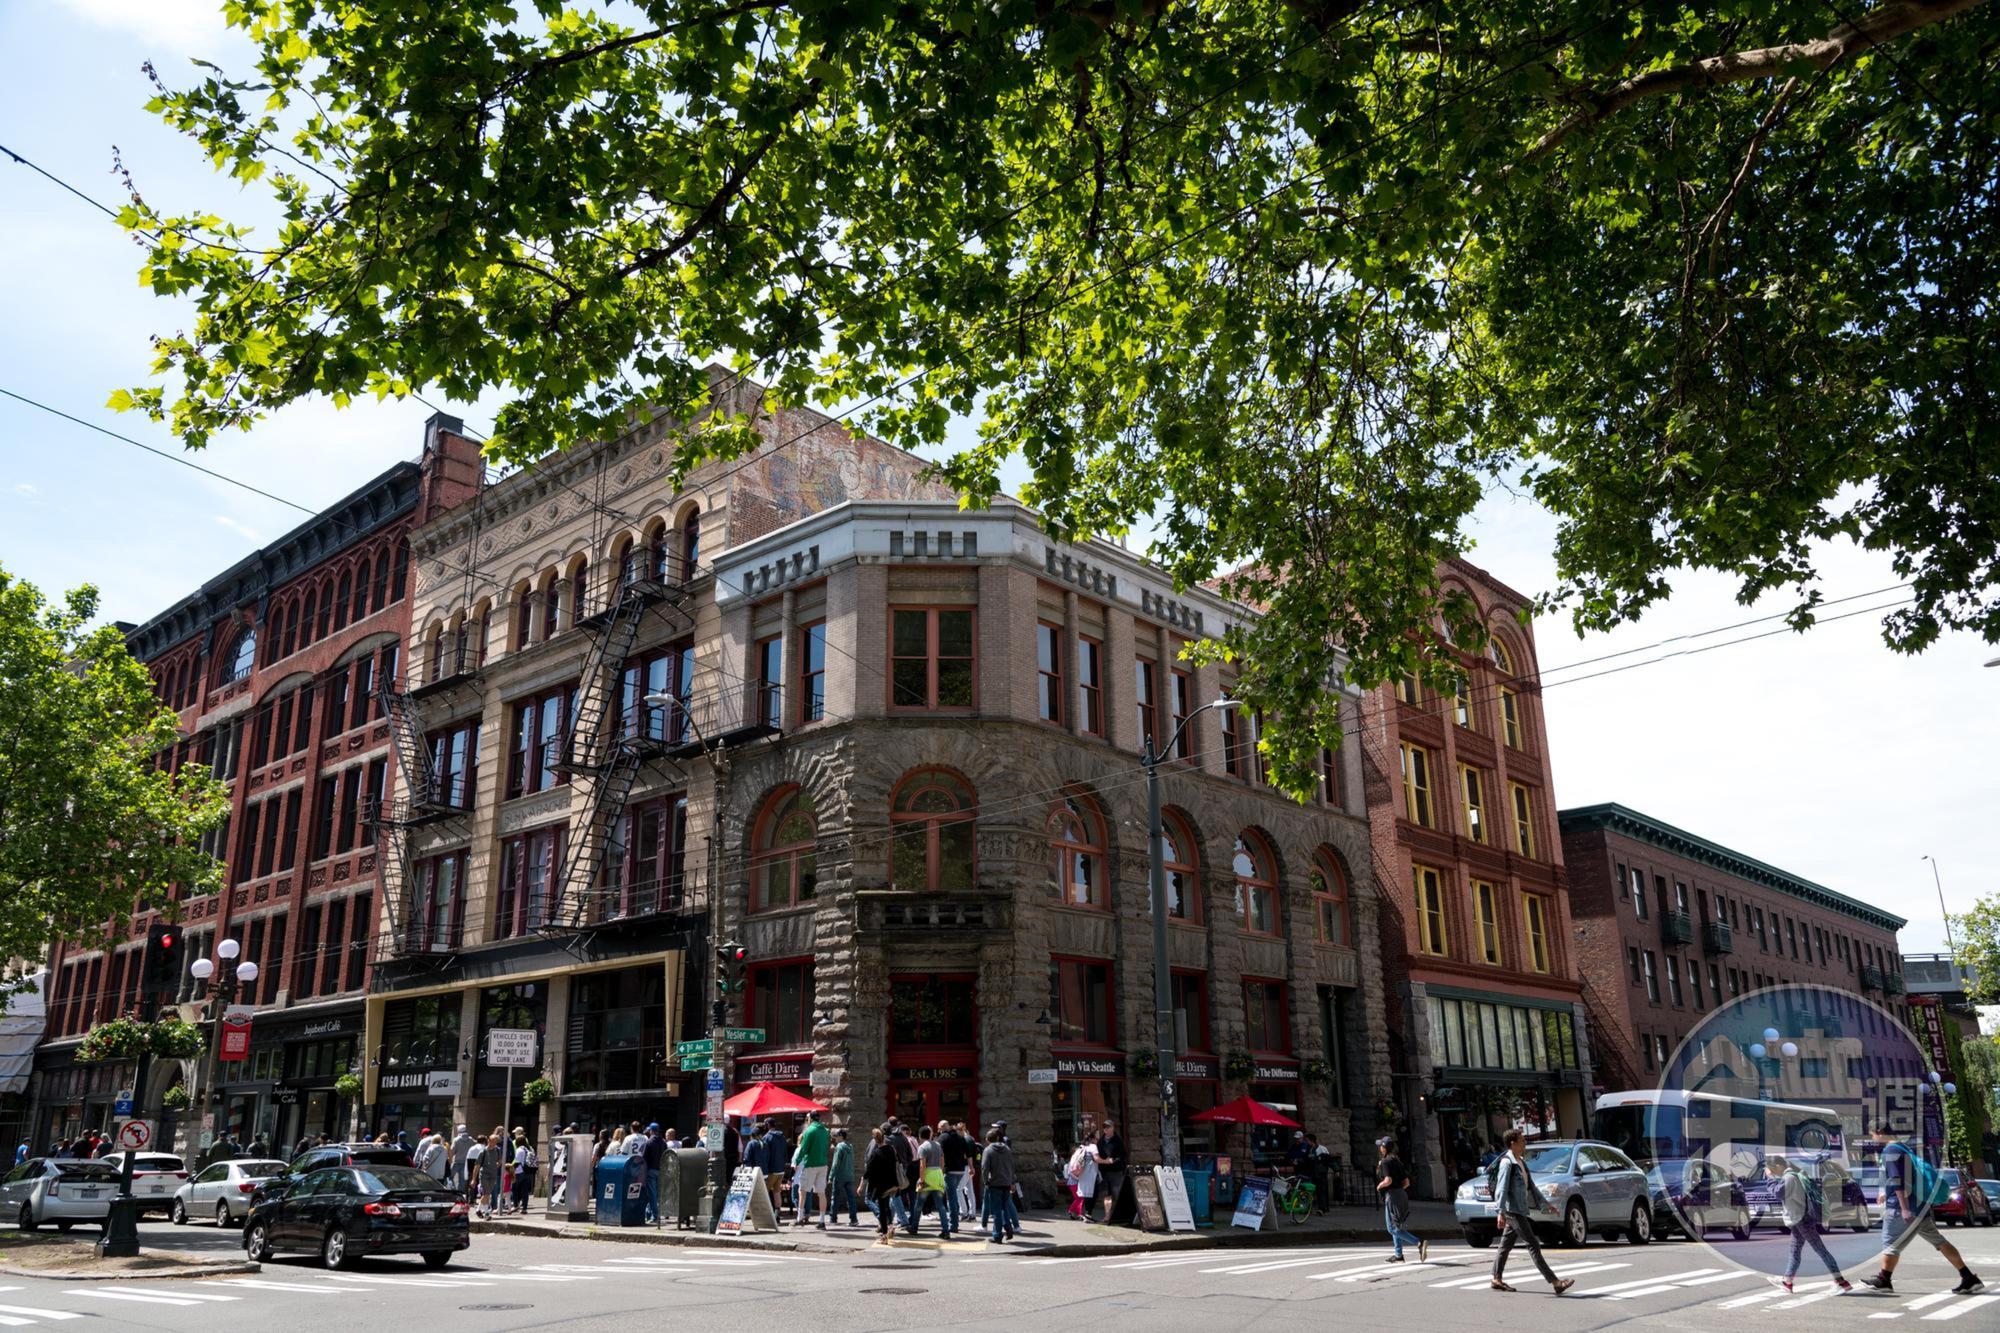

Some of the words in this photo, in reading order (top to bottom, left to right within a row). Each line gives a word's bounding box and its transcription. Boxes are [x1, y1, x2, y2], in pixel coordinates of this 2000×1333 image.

[304, 1023, 327, 1036] Jujubeet
[327, 1020, 341, 1031] Café
[493, 1032, 517, 1040] VEHICLES
[726, 1030, 746, 1040] Yesler
[1924, 1007, 1946, 1072] HOTEL
[1058, 1060, 1077, 1074] Italy
[1078, 1061, 1090, 1072] Via
[1091, 1061, 1116, 1072] Seattle
[1260, 1067, 1271, 1077] The
[1271, 1068, 1298, 1078] Difference
[909, 1068, 929, 1079] Est.
[934, 1068, 957, 1079] 1985
[382, 1075, 399, 1088] KIGO
[400, 1074, 423, 1087] ASIAN
[281, 1094, 297, 1103] Café
[121, 1101, 128, 1109] 2
[1164, 1178, 1183, 1191] CV
